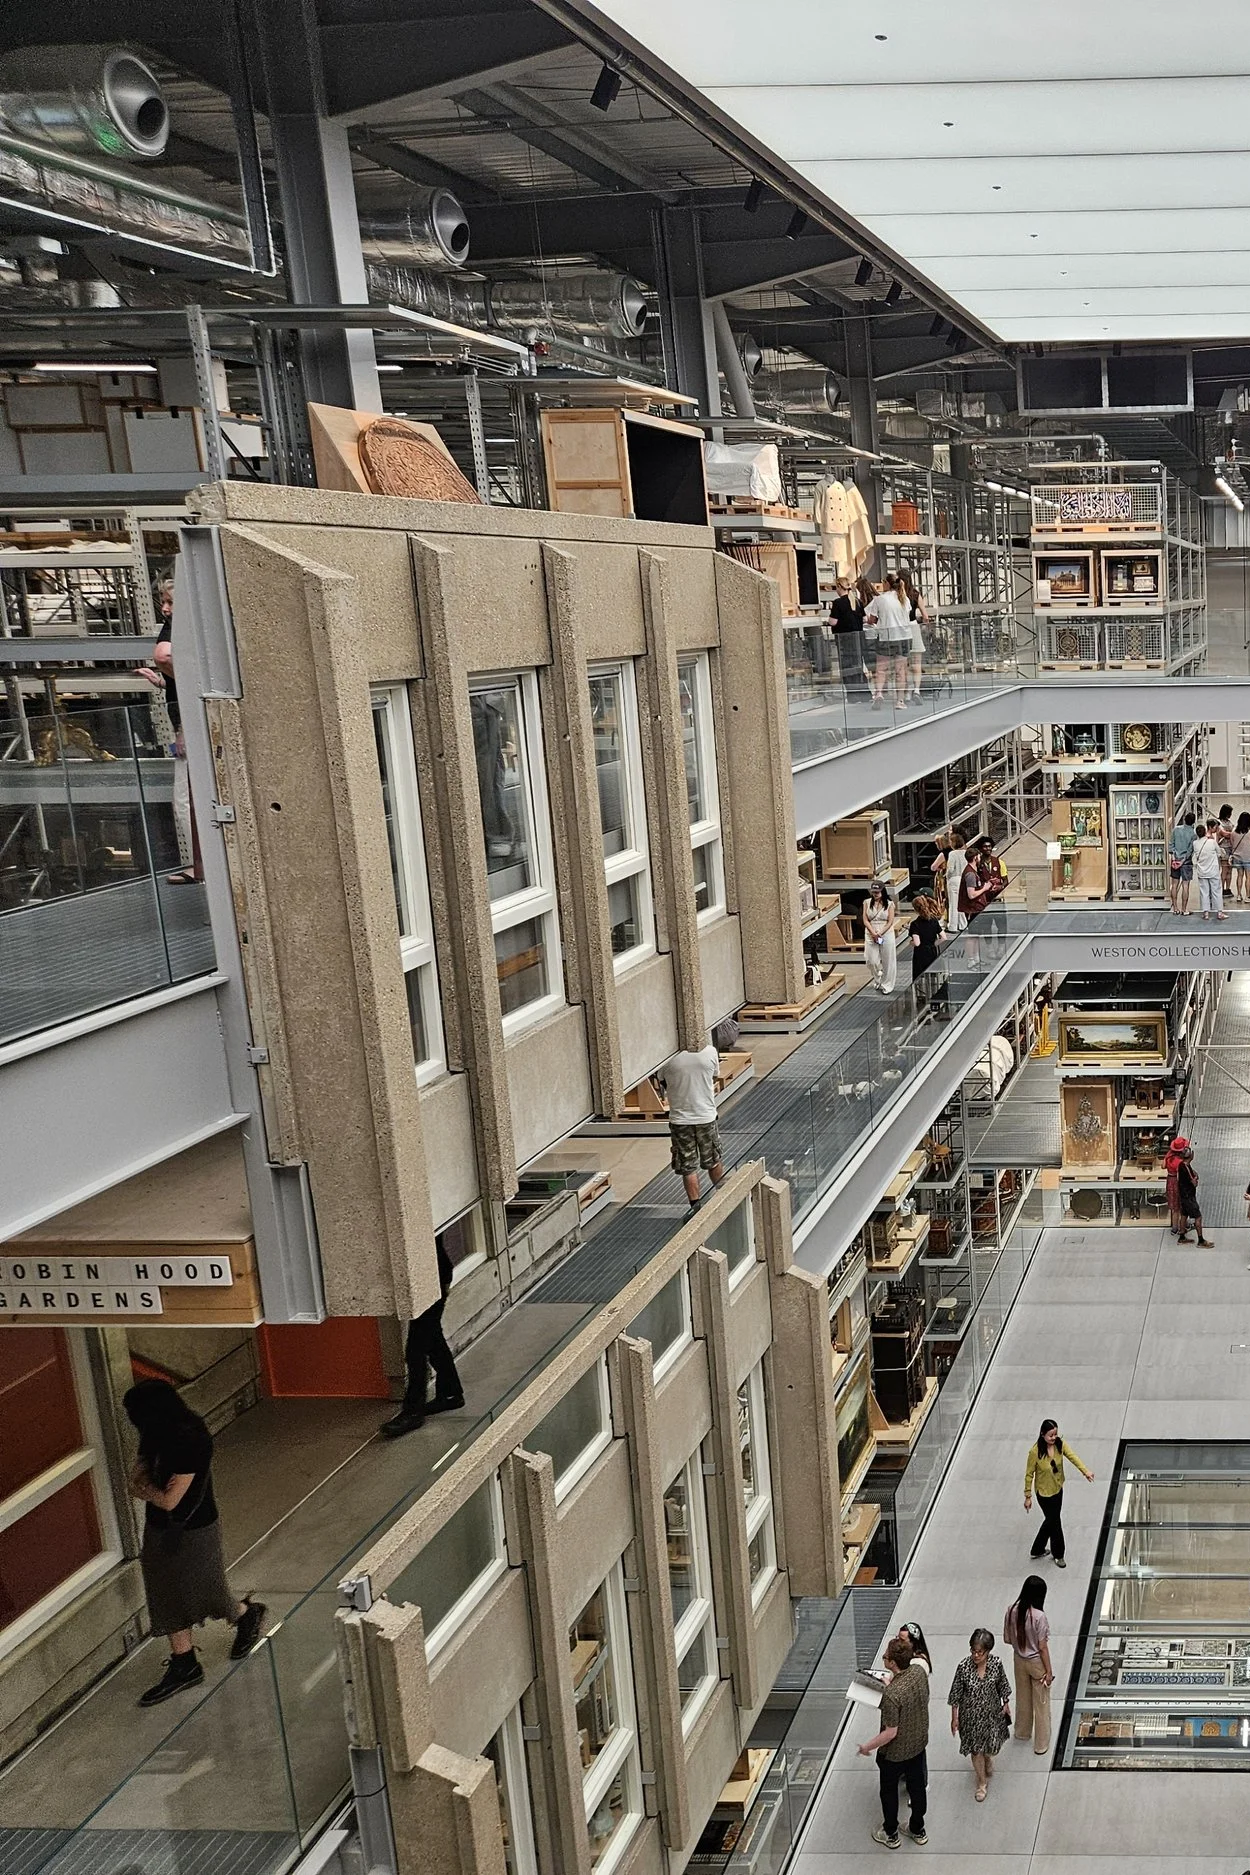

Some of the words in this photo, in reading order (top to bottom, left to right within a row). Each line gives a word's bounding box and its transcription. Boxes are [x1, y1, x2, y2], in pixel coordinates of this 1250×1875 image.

[1091, 947, 1146, 958] WESTON
[1148, 946, 1240, 957] COLLECTIONS
[0, 1263, 100, 1280] OBIN
[135, 1263, 224, 1280] HOOD
[0, 1292, 154, 1309] GARDENS
